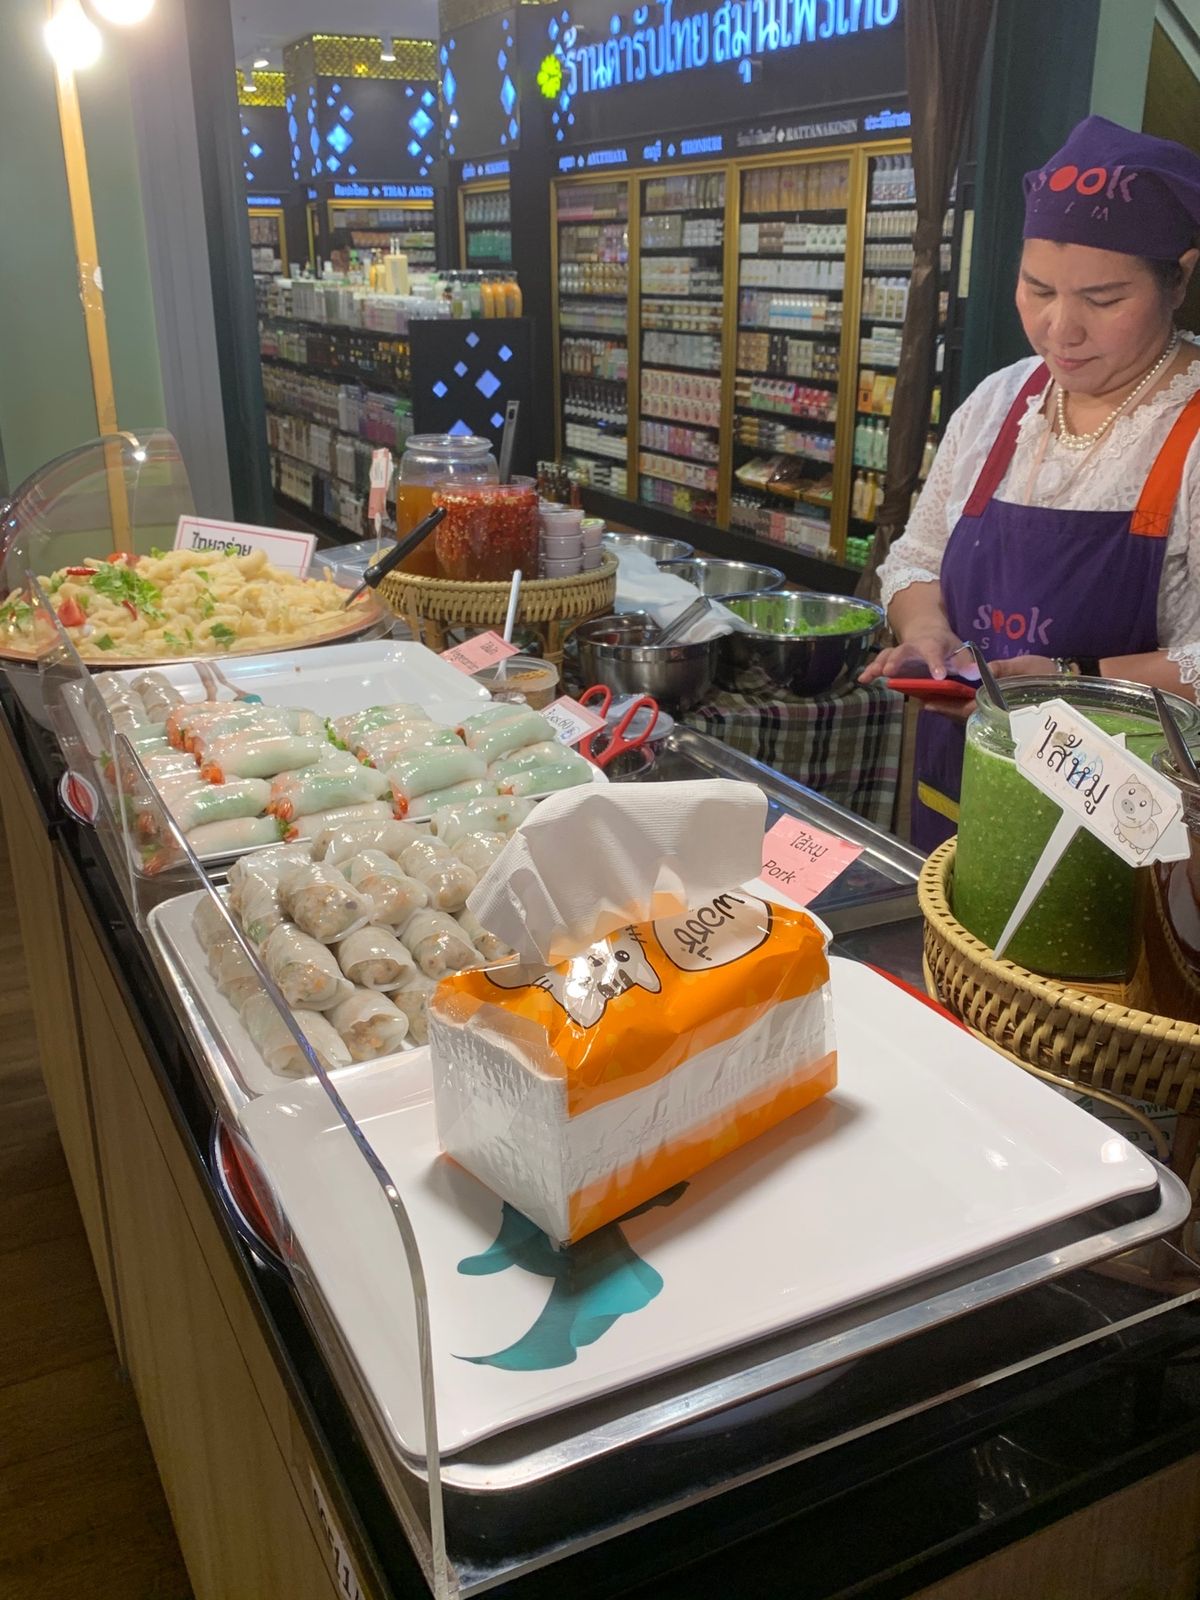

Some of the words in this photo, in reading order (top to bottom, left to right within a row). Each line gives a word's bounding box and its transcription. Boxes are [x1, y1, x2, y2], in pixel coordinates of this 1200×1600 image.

[1035, 714, 1111, 816] ไส้หมู
[789, 830, 829, 863] ไส้หมู
[762, 859, 797, 885] Pork
